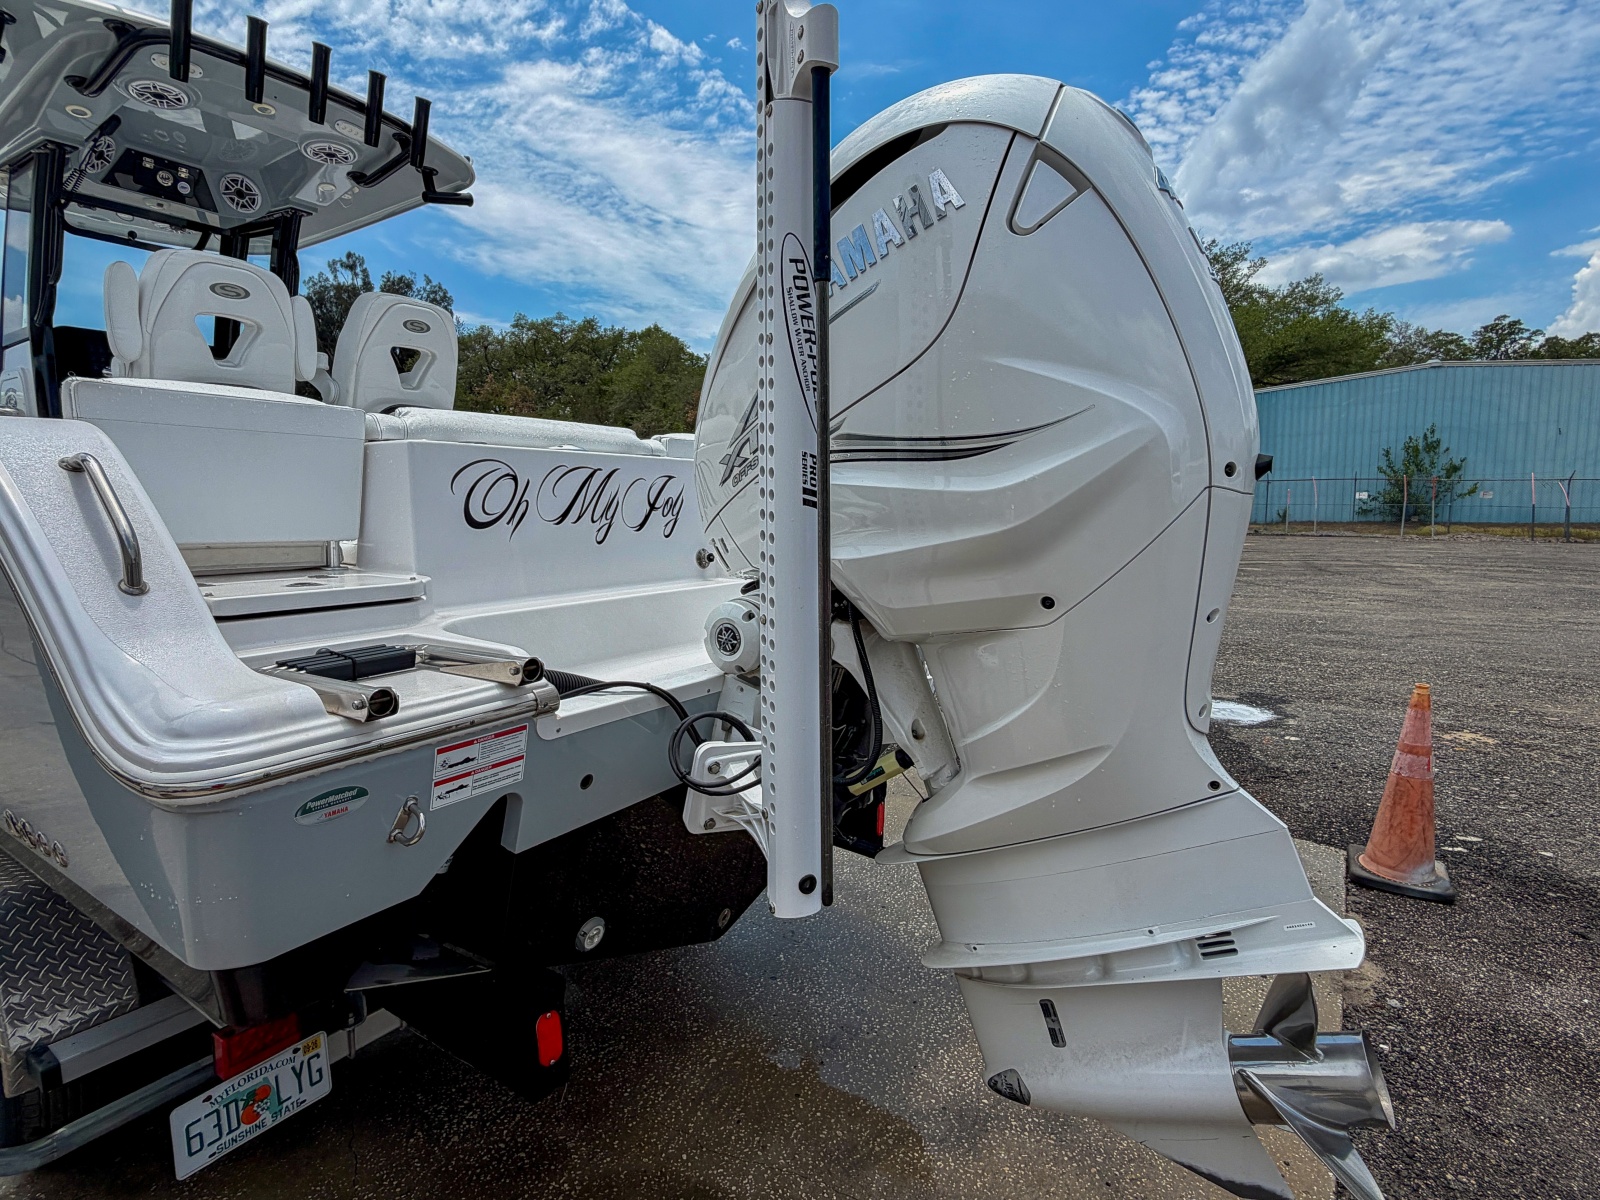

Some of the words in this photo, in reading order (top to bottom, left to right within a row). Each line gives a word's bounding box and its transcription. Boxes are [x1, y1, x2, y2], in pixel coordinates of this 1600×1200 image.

[828, 168, 966, 298] AMAHA
[786, 286, 799, 326] SHALLOW
[794, 327, 805, 357] WATER
[801, 358, 811, 392] ANCHOR
[789, 258, 817, 412] POWER-P
[450, 458, 530, 542] Oh
[536, 464, 621, 545] My
[621, 474, 685, 539] Joy
[732, 455, 759, 487] OFFS
[809, 453, 817, 488] PRO
[306, 788, 358, 810] PowerMatched
[324, 806, 349, 818] YAMAHA
[185, 1099, 242, 1157] 63D
[274, 1052, 323, 1106] LYG
[216, 1118, 267, 1154] SUNSHINE
[271, 1098, 301, 1122] STATE
